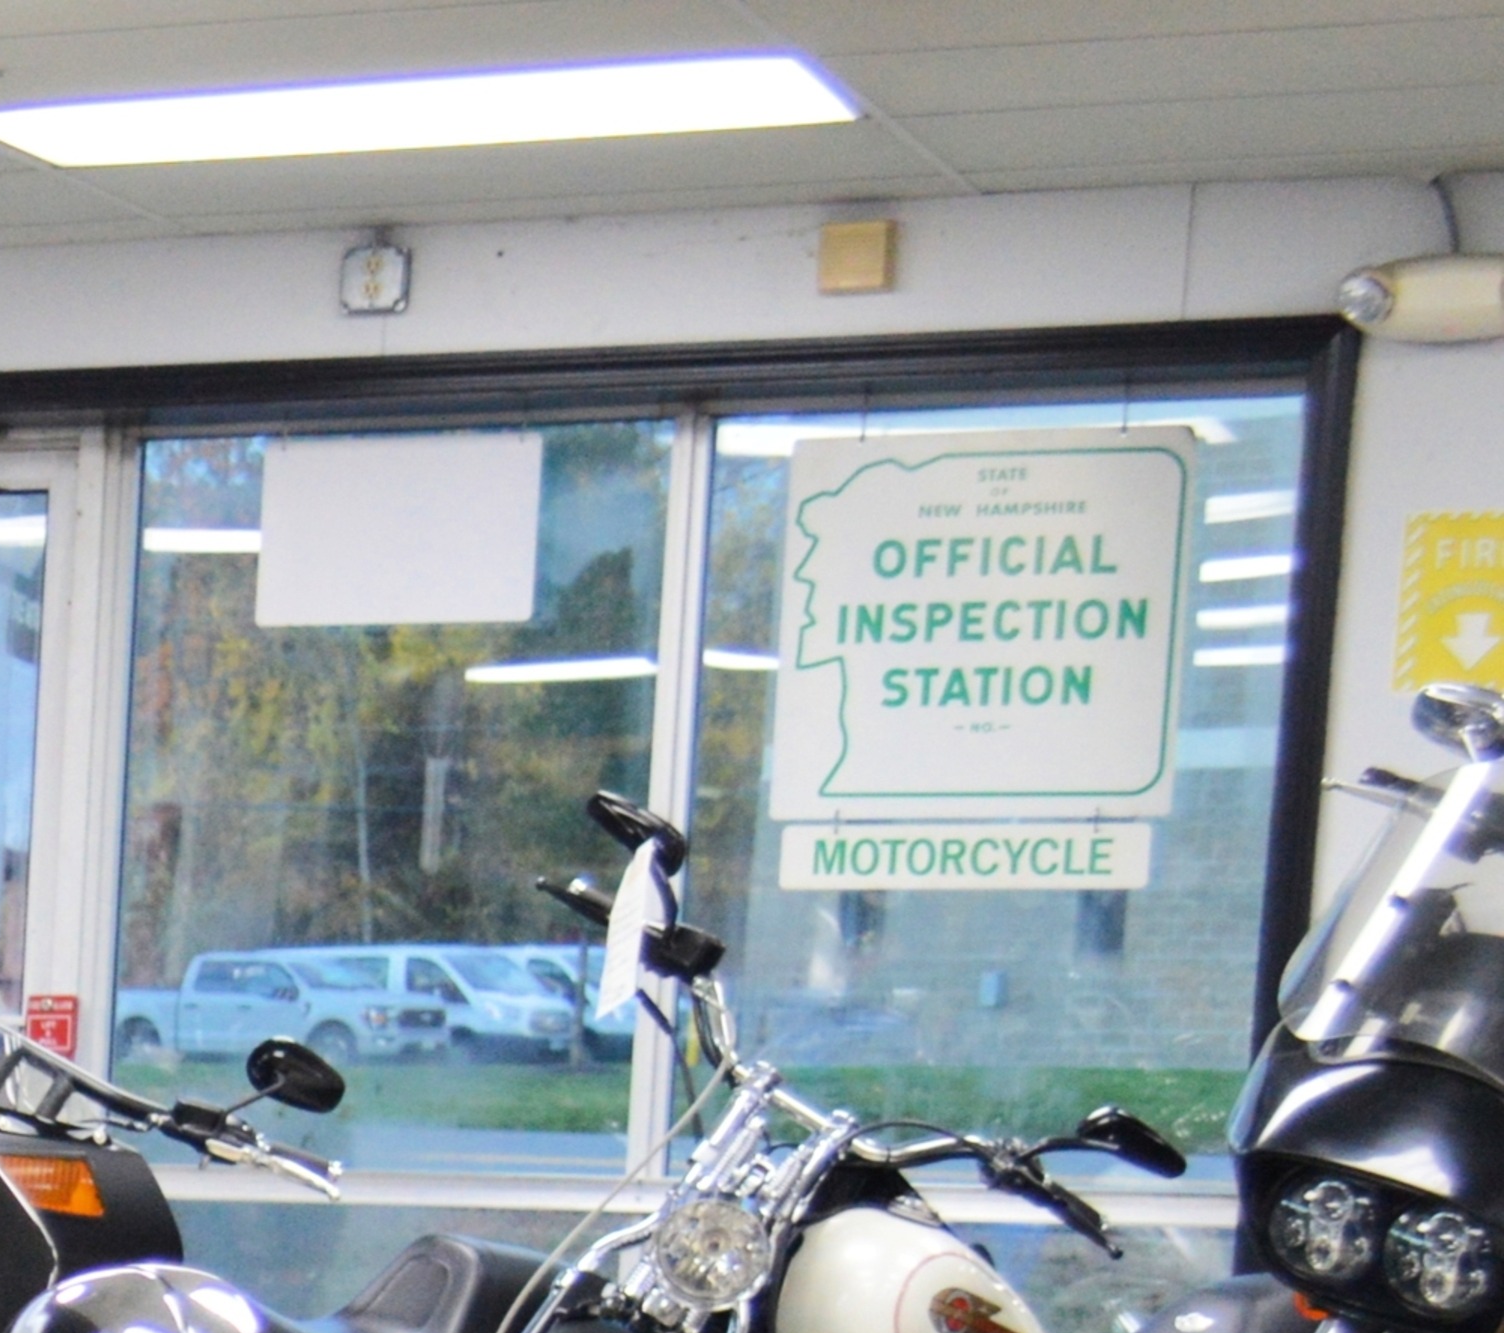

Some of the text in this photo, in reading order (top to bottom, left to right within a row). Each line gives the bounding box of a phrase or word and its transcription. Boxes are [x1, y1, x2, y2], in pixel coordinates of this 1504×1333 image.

[977, 467, 1029, 483] STATE
[918, 500, 1087, 518] NEW HAMPSHIRE
[872, 534, 1118, 579] OFFICIAL
[1435, 537, 1504, 569] FIR
[836, 597, 1148, 645] INSPECTION
[881, 665, 1093, 709] STATION
[812, 838, 1114, 876] MOTORCYCLE
